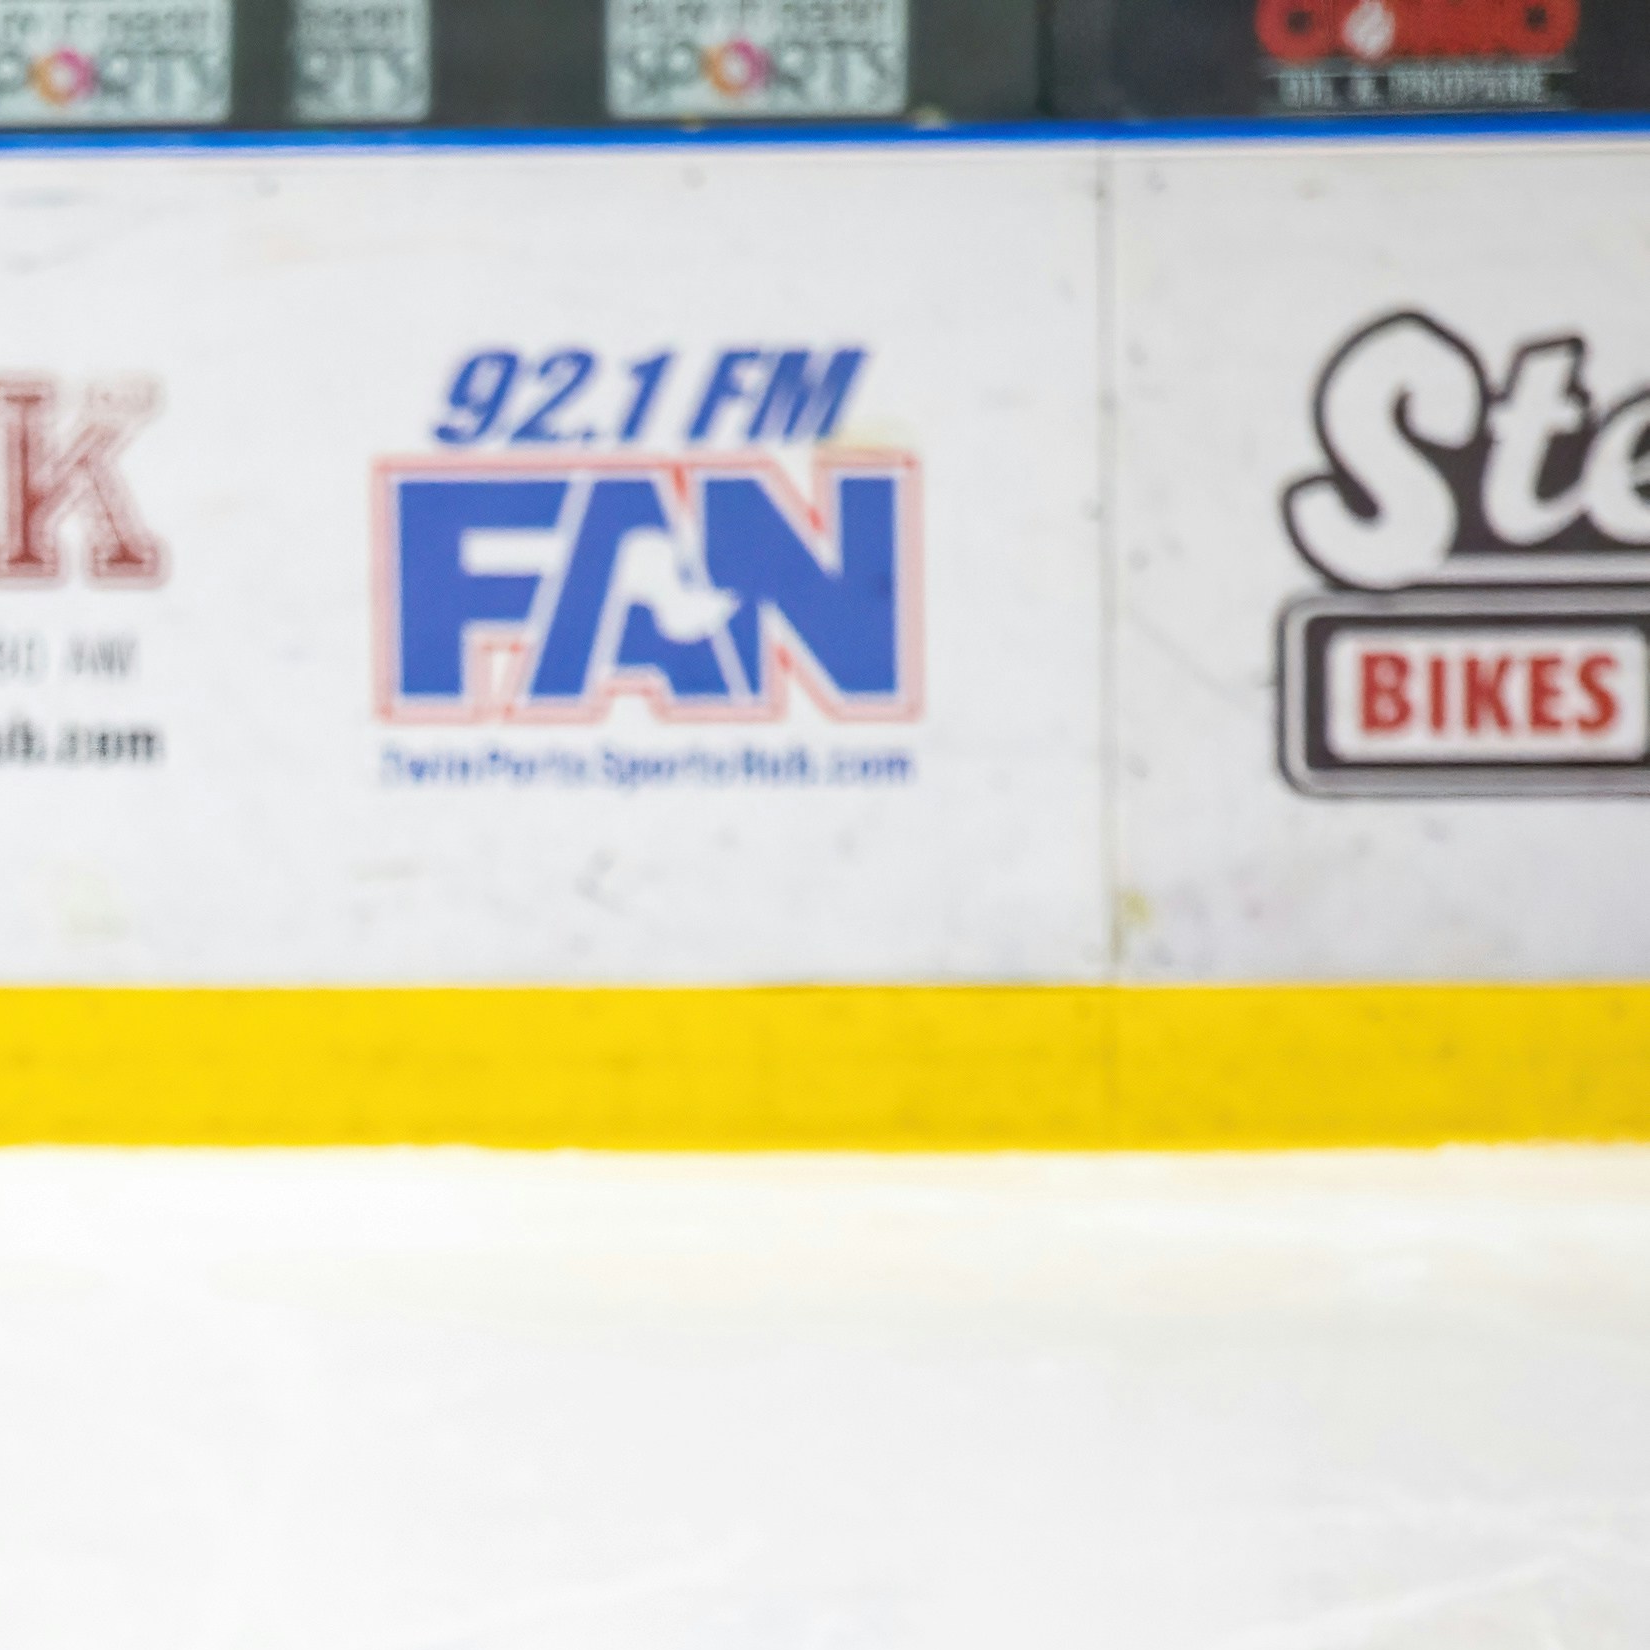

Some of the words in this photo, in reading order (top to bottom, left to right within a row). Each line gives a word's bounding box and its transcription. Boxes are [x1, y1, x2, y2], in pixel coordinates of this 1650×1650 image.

[433, 348, 676, 445] 92.1
[686, 348, 871, 445] FM
[381, 465, 913, 714] FAN
[1357, 650, 1620, 735] BIKES
